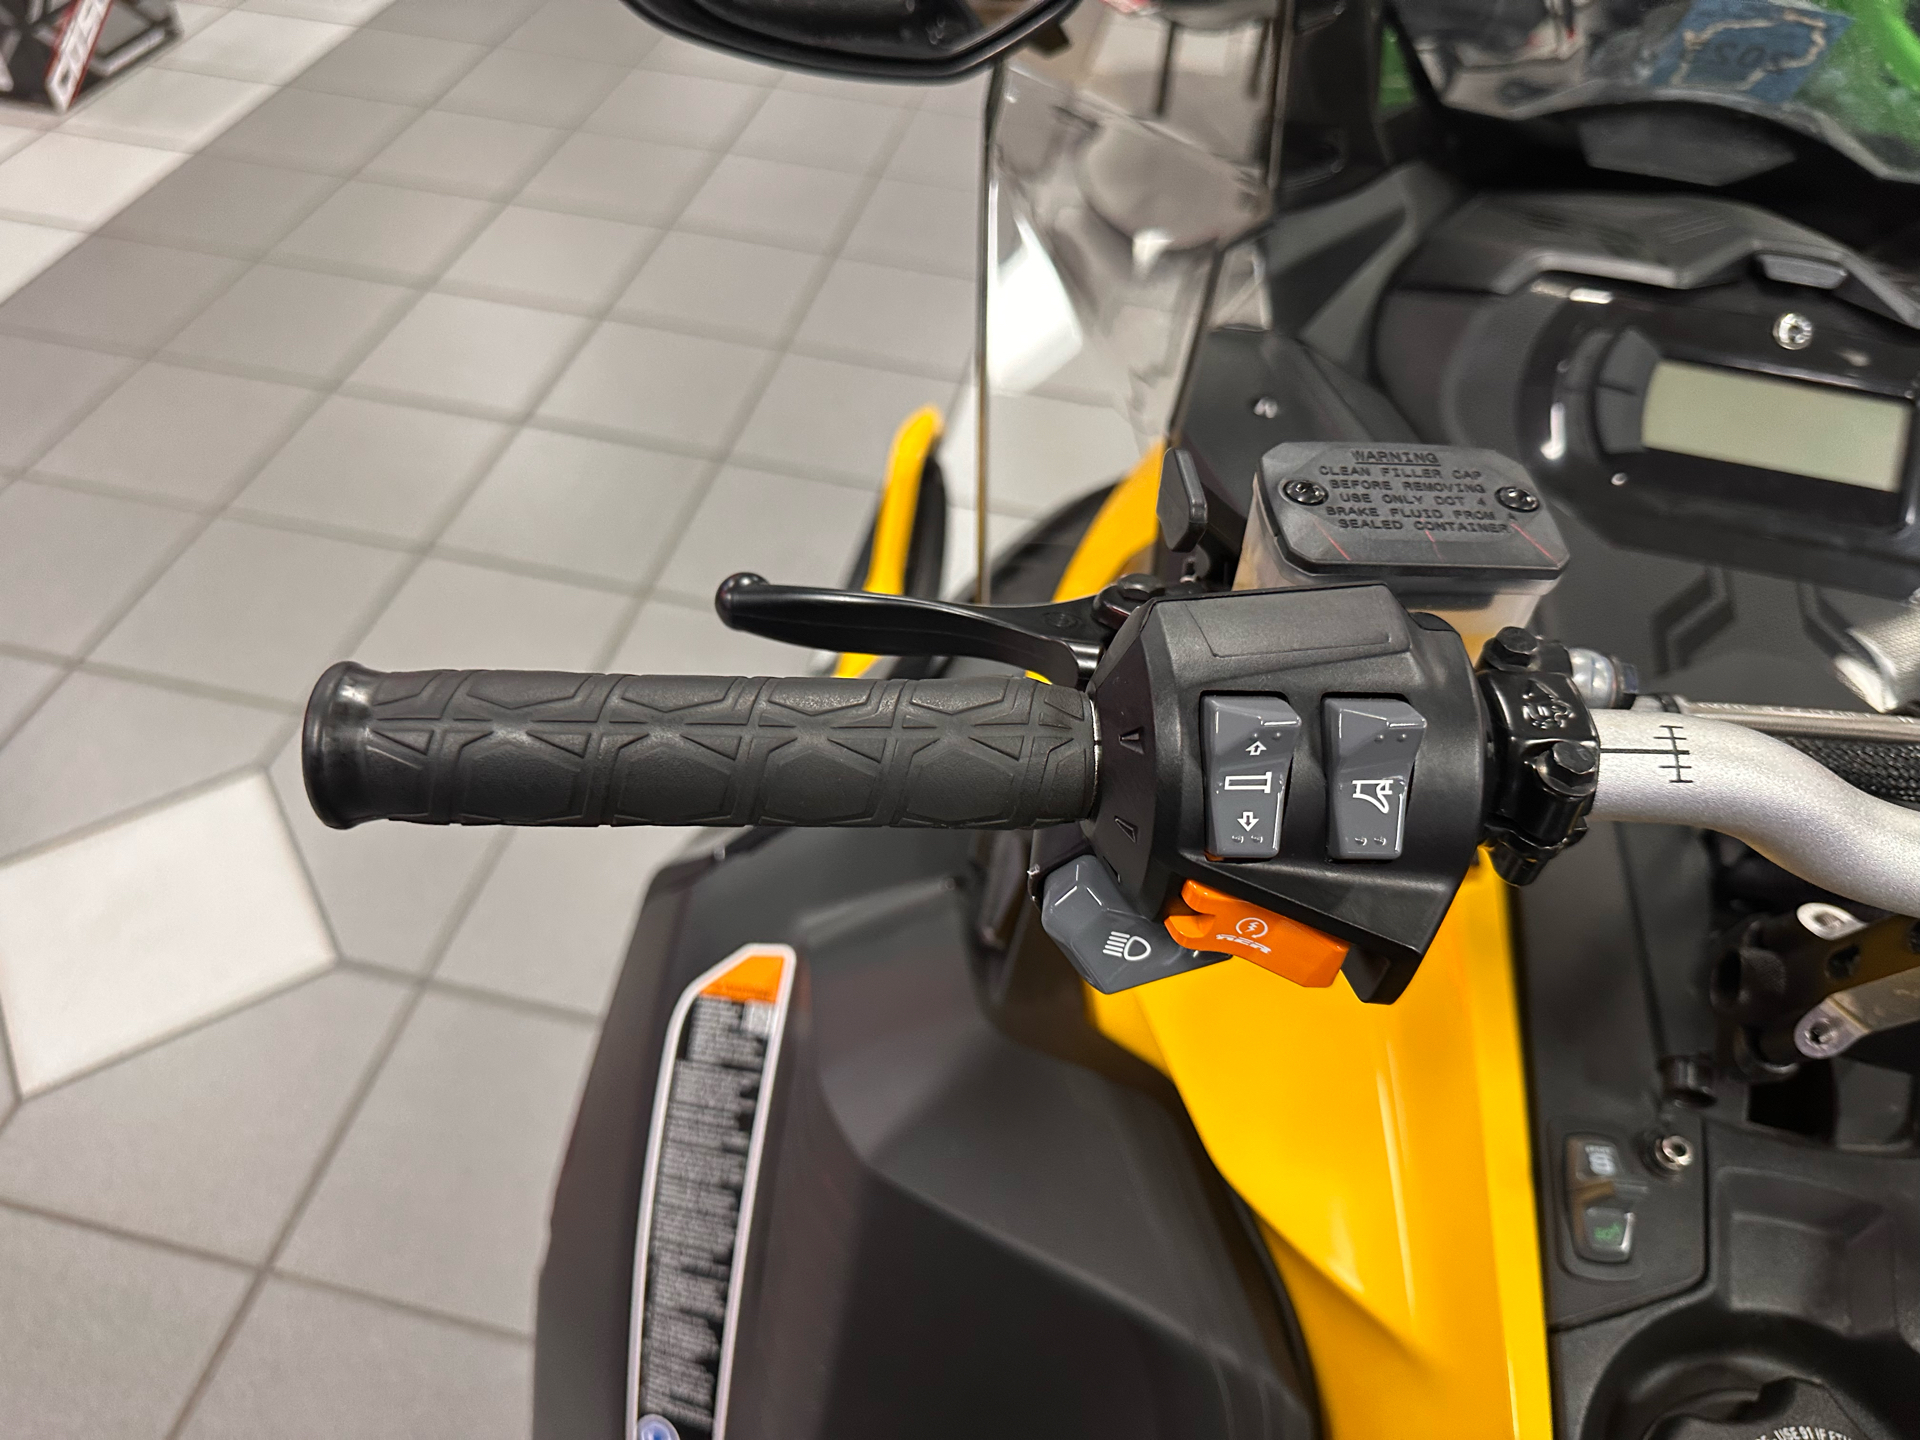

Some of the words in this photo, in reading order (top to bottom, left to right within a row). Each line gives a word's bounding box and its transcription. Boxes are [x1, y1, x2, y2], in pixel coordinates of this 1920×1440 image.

[1349, 450, 1440, 464] WARNING
[1319, 465, 1371, 477] CLEAN
[1380, 467, 1444, 479] FILLER
[1452, 469, 1482, 480] CAP
[1329, 479, 1393, 491] BEFORE
[1402, 481, 1487, 494] REMOVING
[1339, 493, 1373, 504] USE
[1381, 494, 1423, 505] ONLY
[1433, 496, 1465, 506] DOT
[1476, 498, 1487, 507] 4
[1325, 506, 1380, 517] BRAKE
[1389, 508, 1444, 519] FLUID
[1452, 509, 1497, 521] FROM
[1507, 512, 1519, 522] A
[1338, 518, 1404, 530] SEALED
[1413, 520, 1515, 534] CONTAINER
